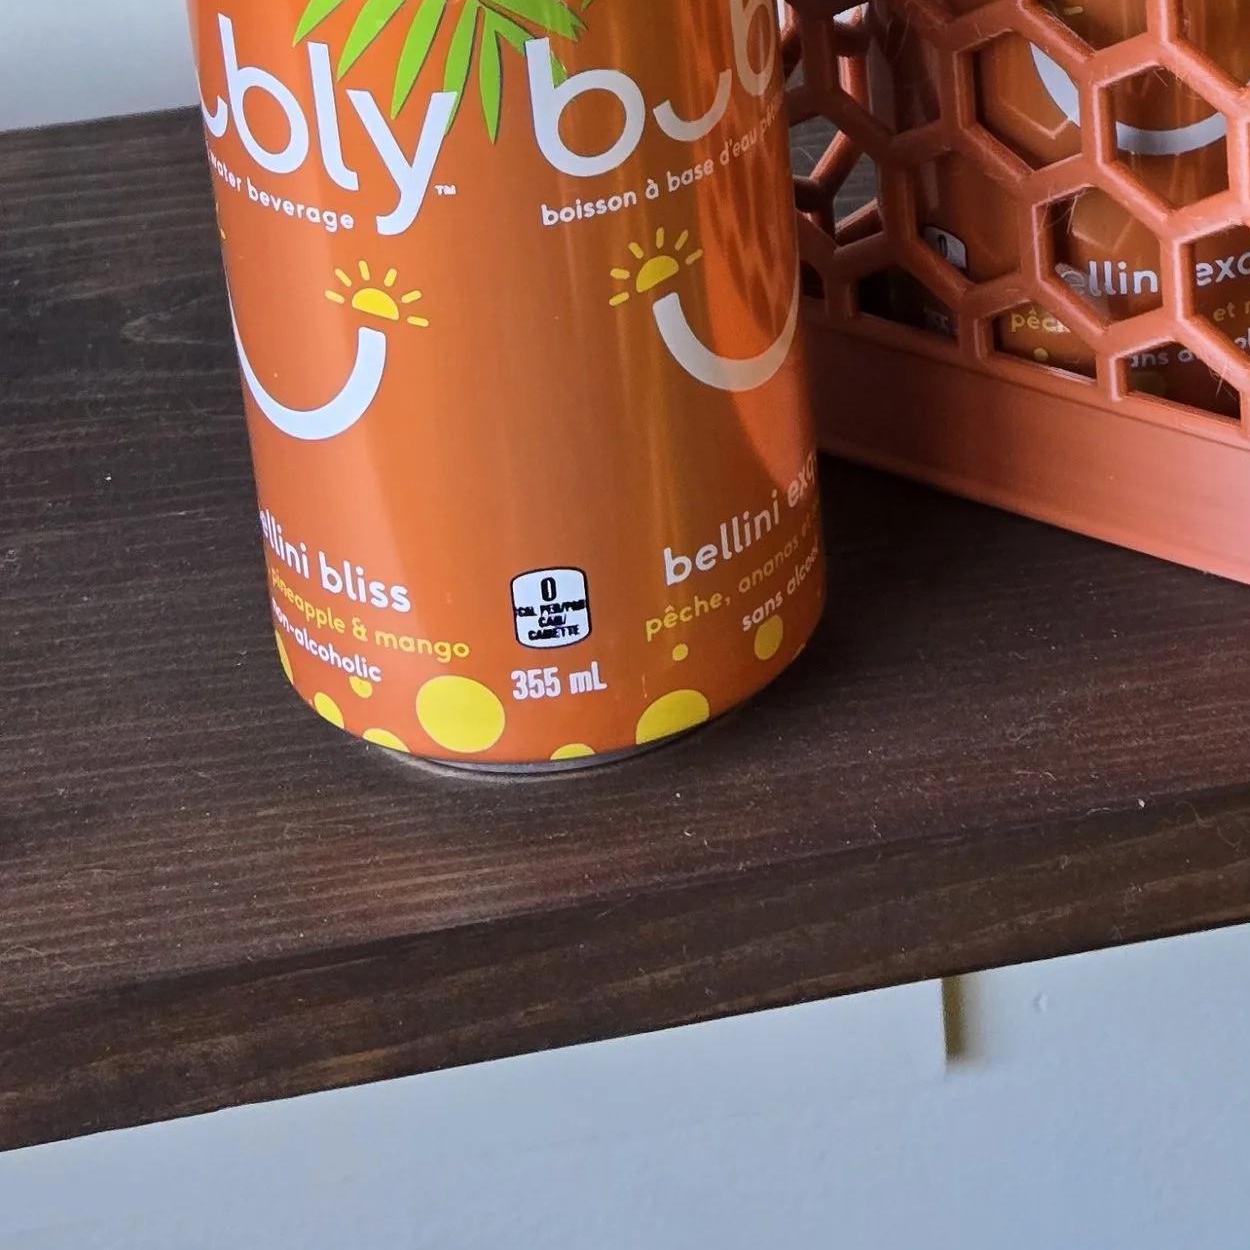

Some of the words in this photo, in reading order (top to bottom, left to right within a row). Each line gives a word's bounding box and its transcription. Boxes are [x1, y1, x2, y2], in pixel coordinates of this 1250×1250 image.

[540, 189, 638, 228] boisson
[645, 177, 660, 201] à
[666, 160, 715, 193] base
[719, 126, 758, 167] d'eau
[246, 176, 355, 233] beverage
[1212, 301, 1236, 323] et
[663, 488, 780, 587] bellini
[318, 550, 412, 613] bliss
[540, 576, 557, 602] 0
[644, 591, 732, 643] pêche,
[737, 533, 799, 595] ananas
[742, 590, 784, 632] sans
[351, 616, 370, 643] &
[374, 628, 471, 664] mango
[510, 666, 562, 700] 355
[568, 660, 608, 695] mL
